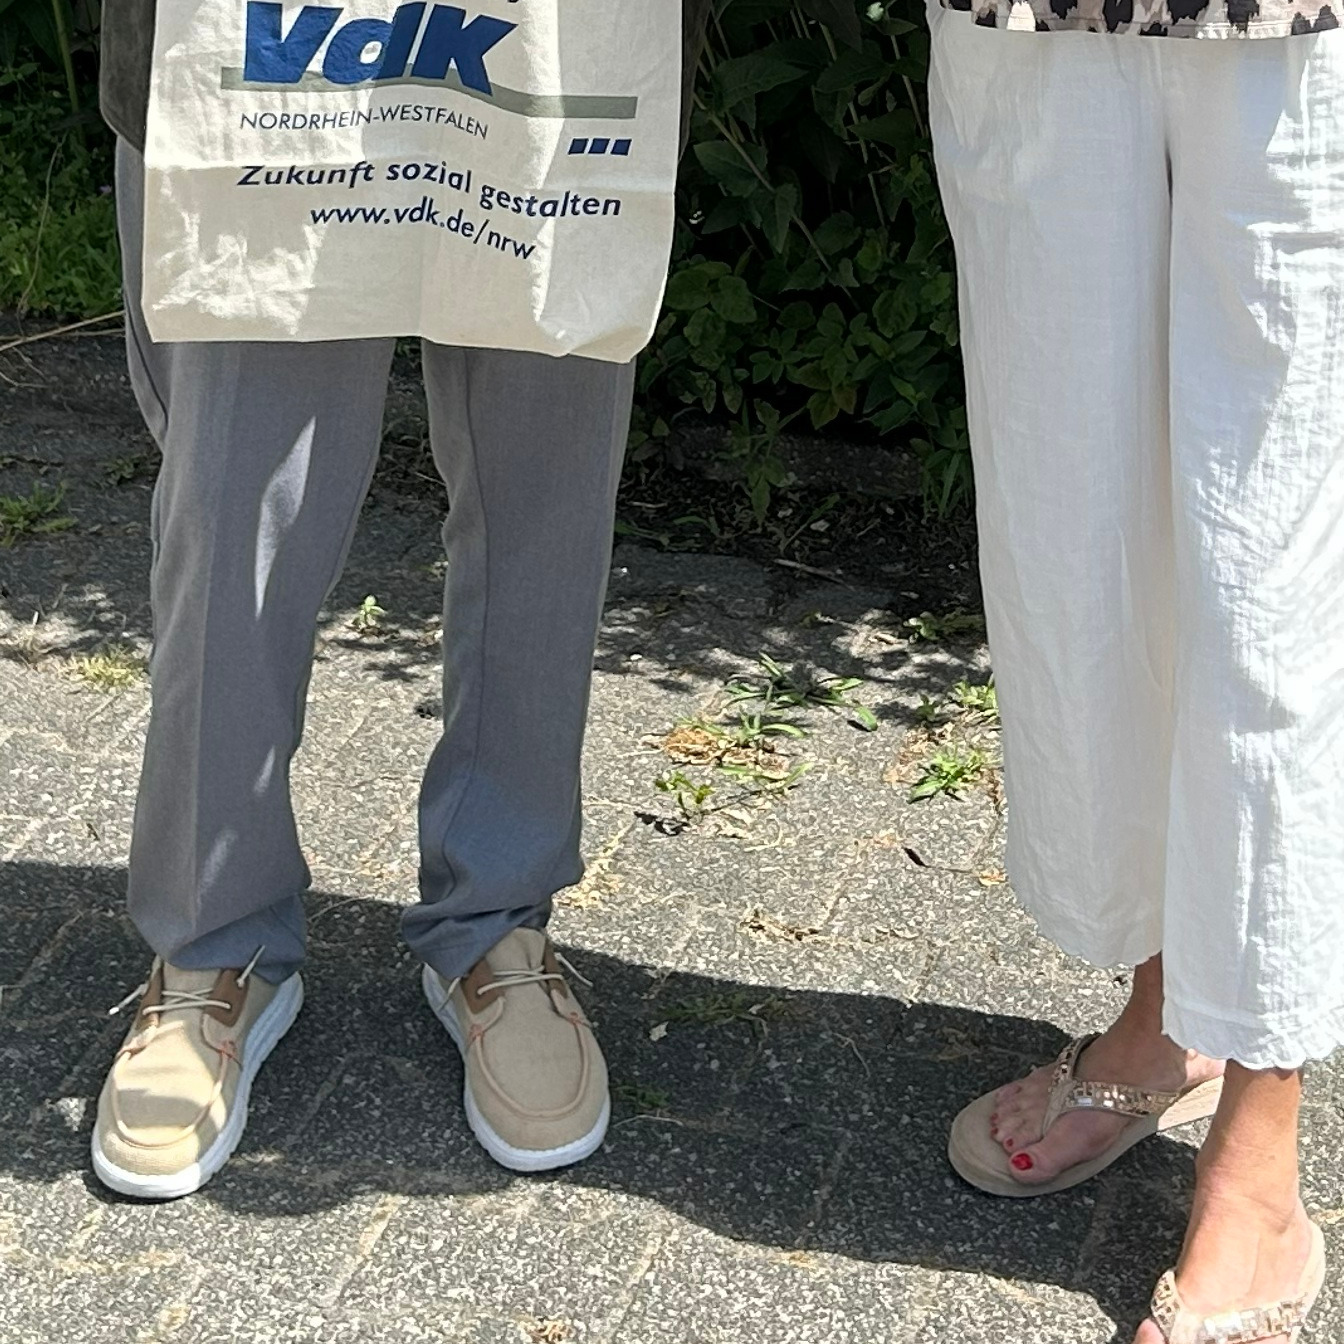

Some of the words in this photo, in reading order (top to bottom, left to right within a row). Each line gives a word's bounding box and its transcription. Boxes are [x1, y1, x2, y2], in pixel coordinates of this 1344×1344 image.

[243, 0, 519, 97] VdK
[239, 103, 490, 140] NORDRHEIN-WESTFALEN
[236, 160, 375, 190] Zukunft
[386, 160, 472, 194] sozial
[479, 184, 623, 219] gestalten
[309, 196, 537, 260] www.vdk.de/nrw
